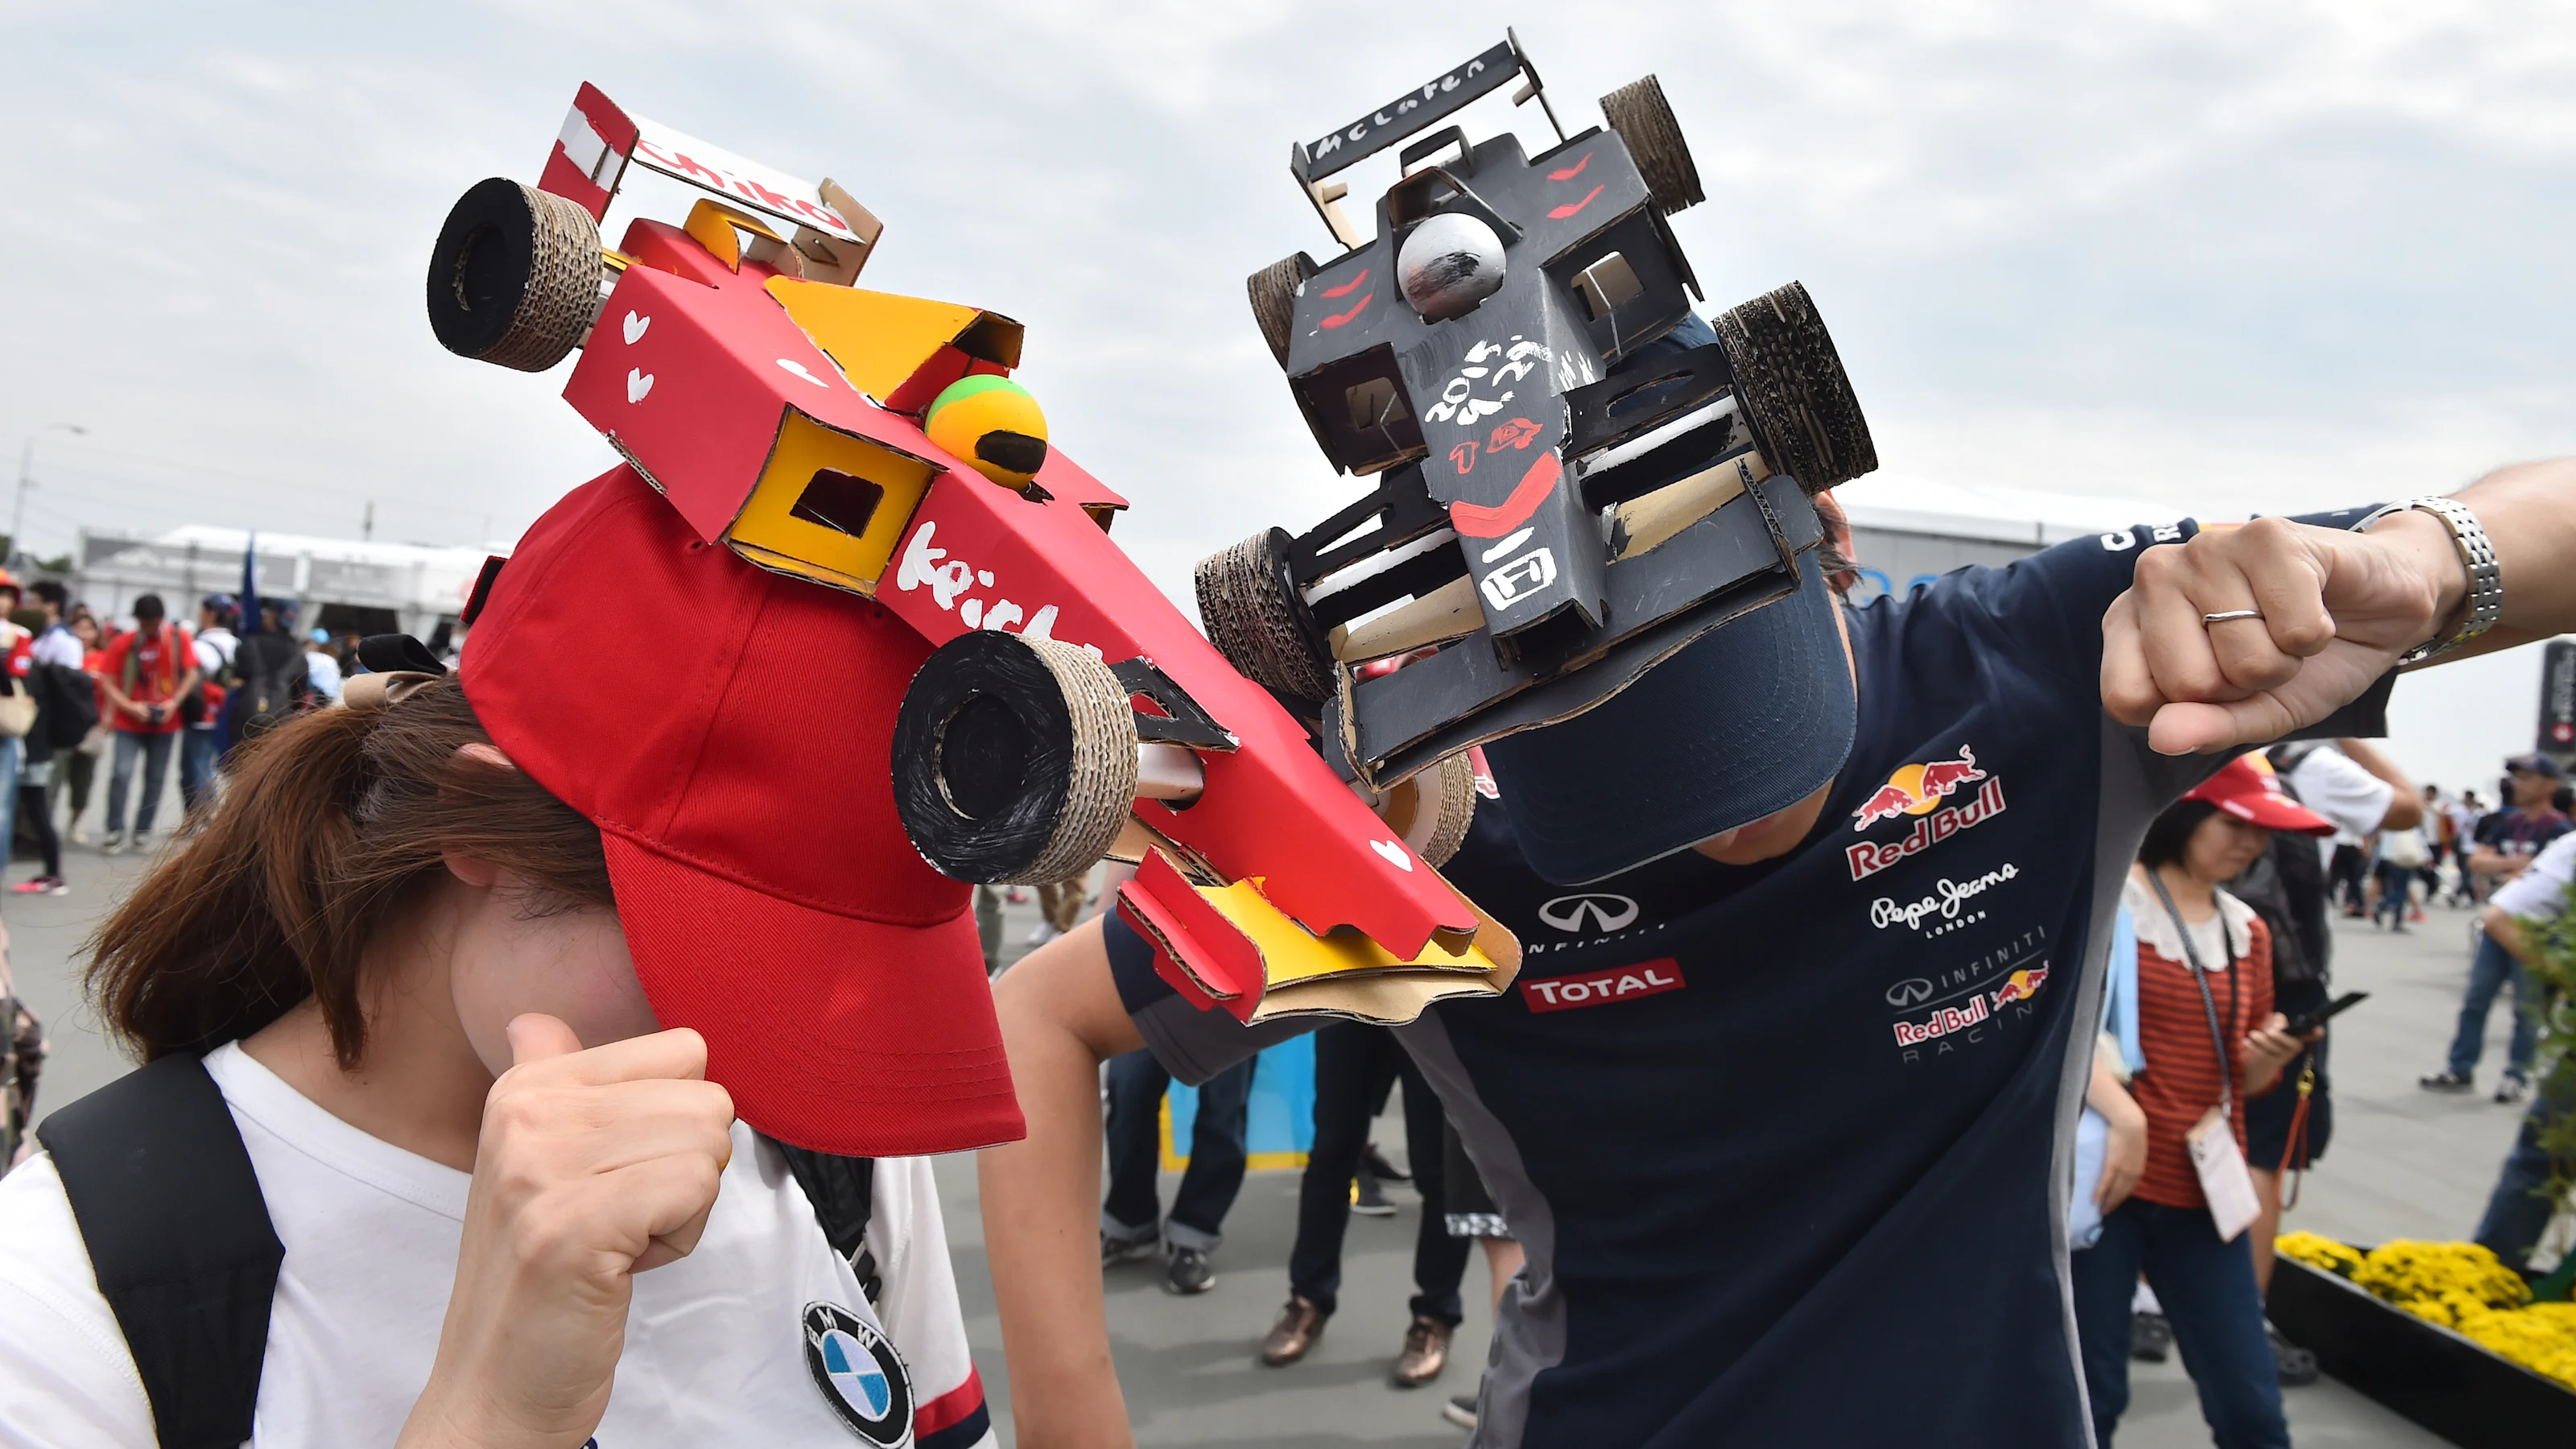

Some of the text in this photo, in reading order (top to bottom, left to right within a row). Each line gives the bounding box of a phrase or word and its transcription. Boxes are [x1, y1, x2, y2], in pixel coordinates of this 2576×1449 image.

[1847, 776, 2005, 881] Red Bull
[1870, 862, 2019, 931] Pepe Jeans
[1926, 910, 1987, 939] LONDON
[1942, 926, 2046, 988] INFINITI
[1530, 968, 1675, 1005] TOTAL
[1893, 994, 1989, 1046] Red Bull
[1902, 1002, 2033, 1064] RACIN
[807, 1307, 878, 1352] BMW
